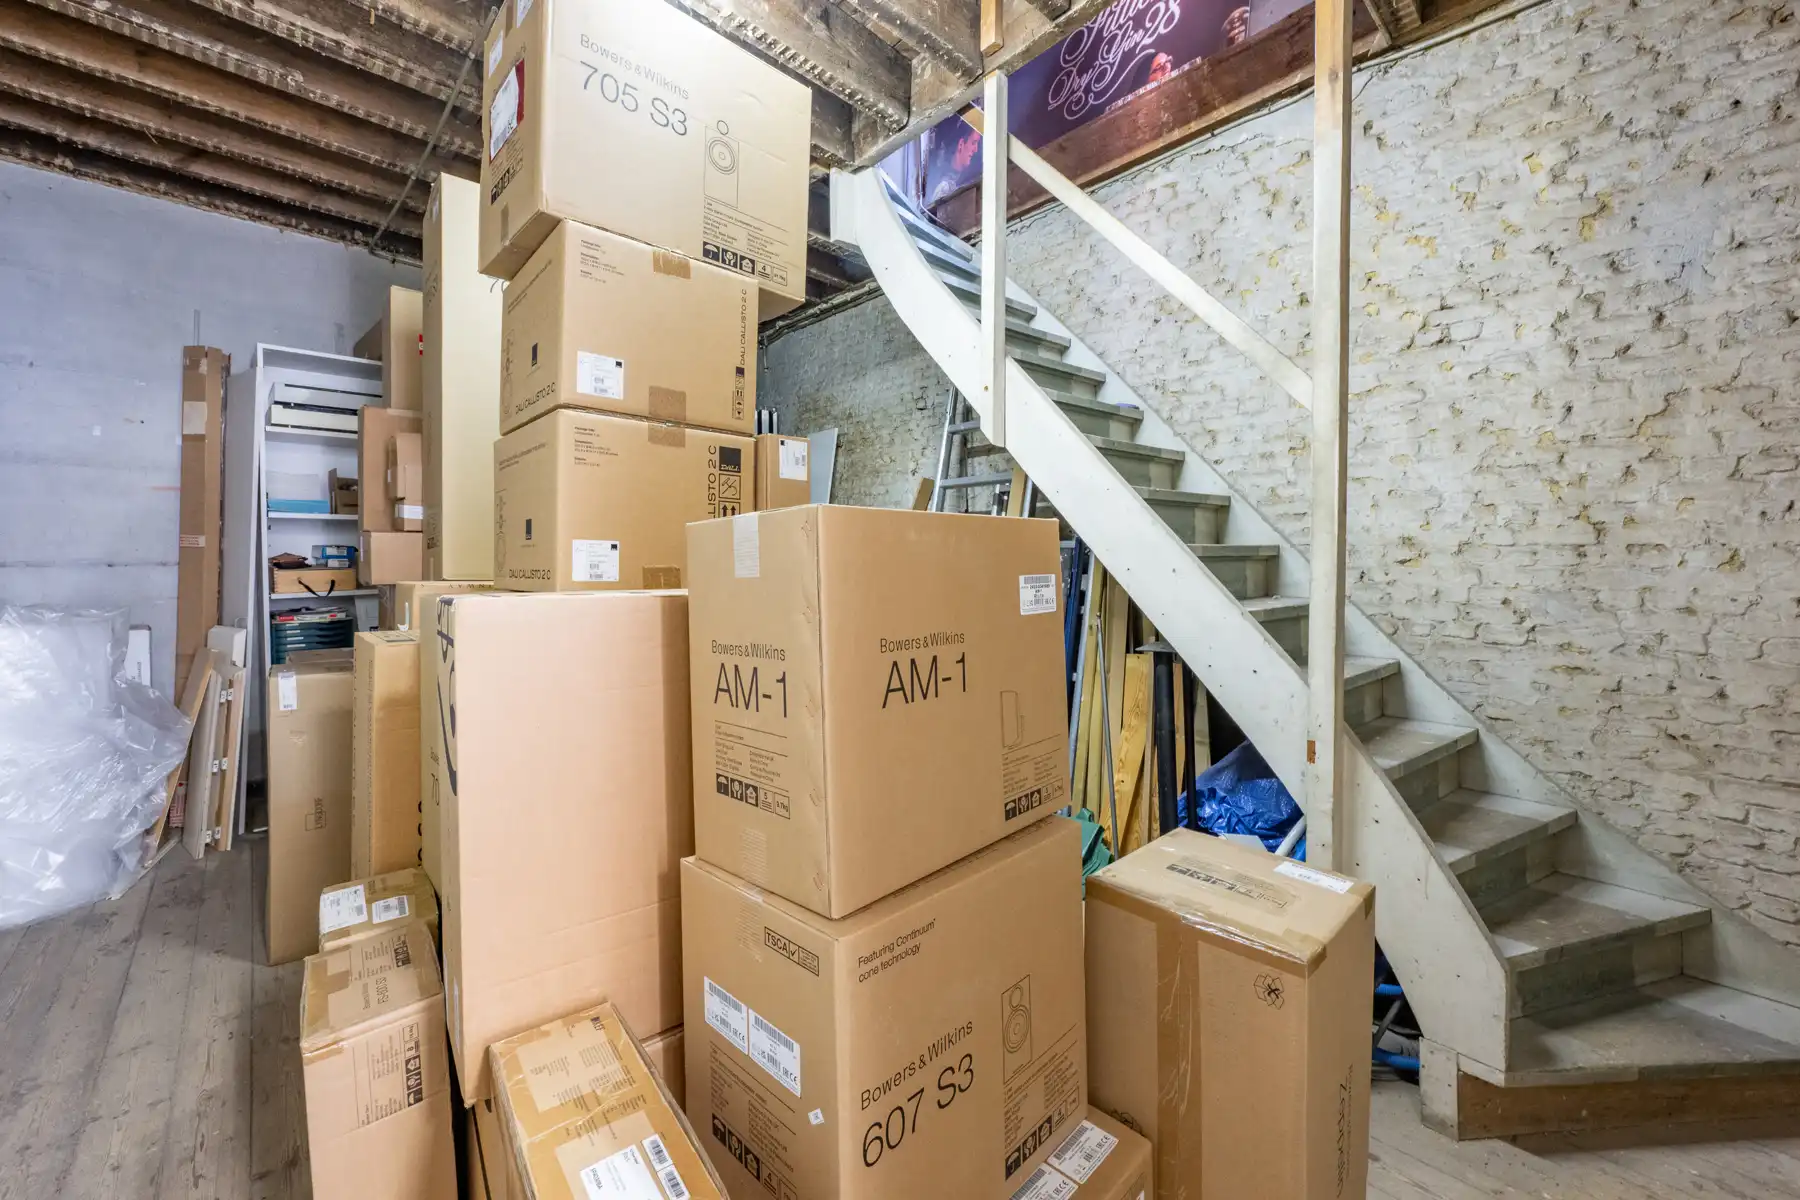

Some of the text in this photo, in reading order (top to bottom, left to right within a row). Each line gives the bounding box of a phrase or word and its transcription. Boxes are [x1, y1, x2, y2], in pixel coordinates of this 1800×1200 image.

[580, 33, 632, 71] Bowers
[644, 66, 689, 100] Wilkins
[1092, 20, 1145, 91] Gin
[1136, 0, 1181, 54] 28
[580, 60, 688, 136] 705 S3
[708, 445, 716, 519] LISTO 2 C
[712, 640, 743, 657] Bowers
[750, 642, 786, 661] Wilkins
[880, 632, 965, 653] Bowers & Wilkins
[714, 662, 787, 718] AM-1
[882, 652, 966, 709] AM-1
[766, 932, 789, 954] TSCA
[858, 942, 894, 968] Featuring
[859, 942, 921, 982] cone technology
[861, 1021, 972, 1111] Bowers & Wilkins
[862, 1087, 925, 1168] 607
[937, 1053, 974, 1109] S3
